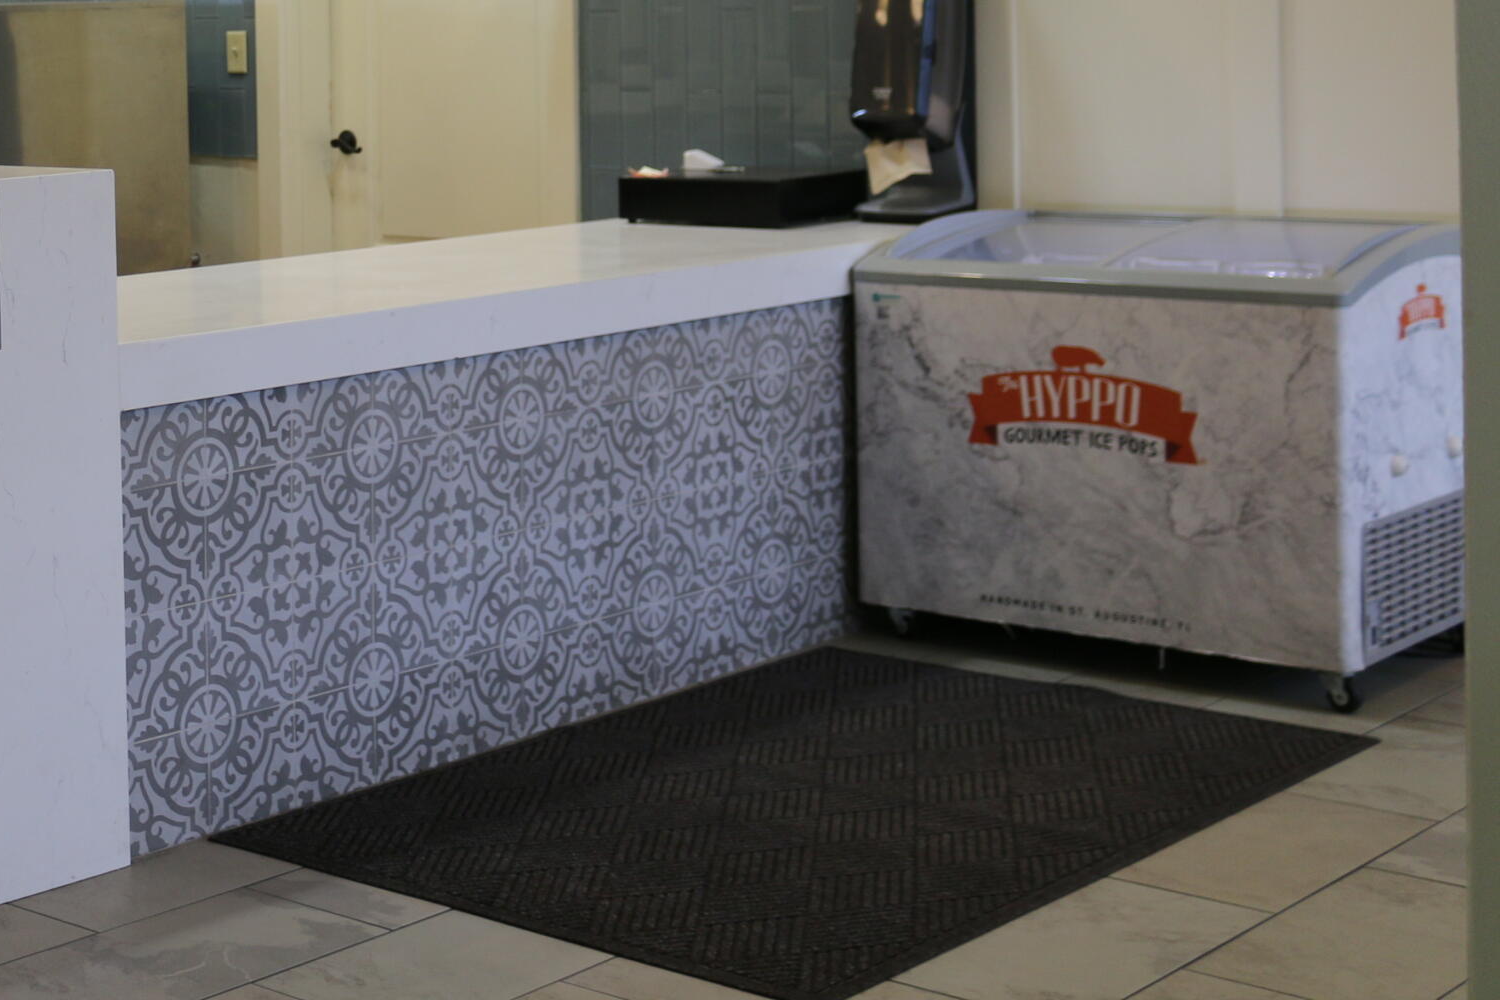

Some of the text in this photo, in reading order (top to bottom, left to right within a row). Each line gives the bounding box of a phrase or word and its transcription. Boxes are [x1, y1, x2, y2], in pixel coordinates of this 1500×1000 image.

[1019, 374, 1141, 428] HYPPO
[1003, 427, 1158, 458] GOURMET ICE POPS
